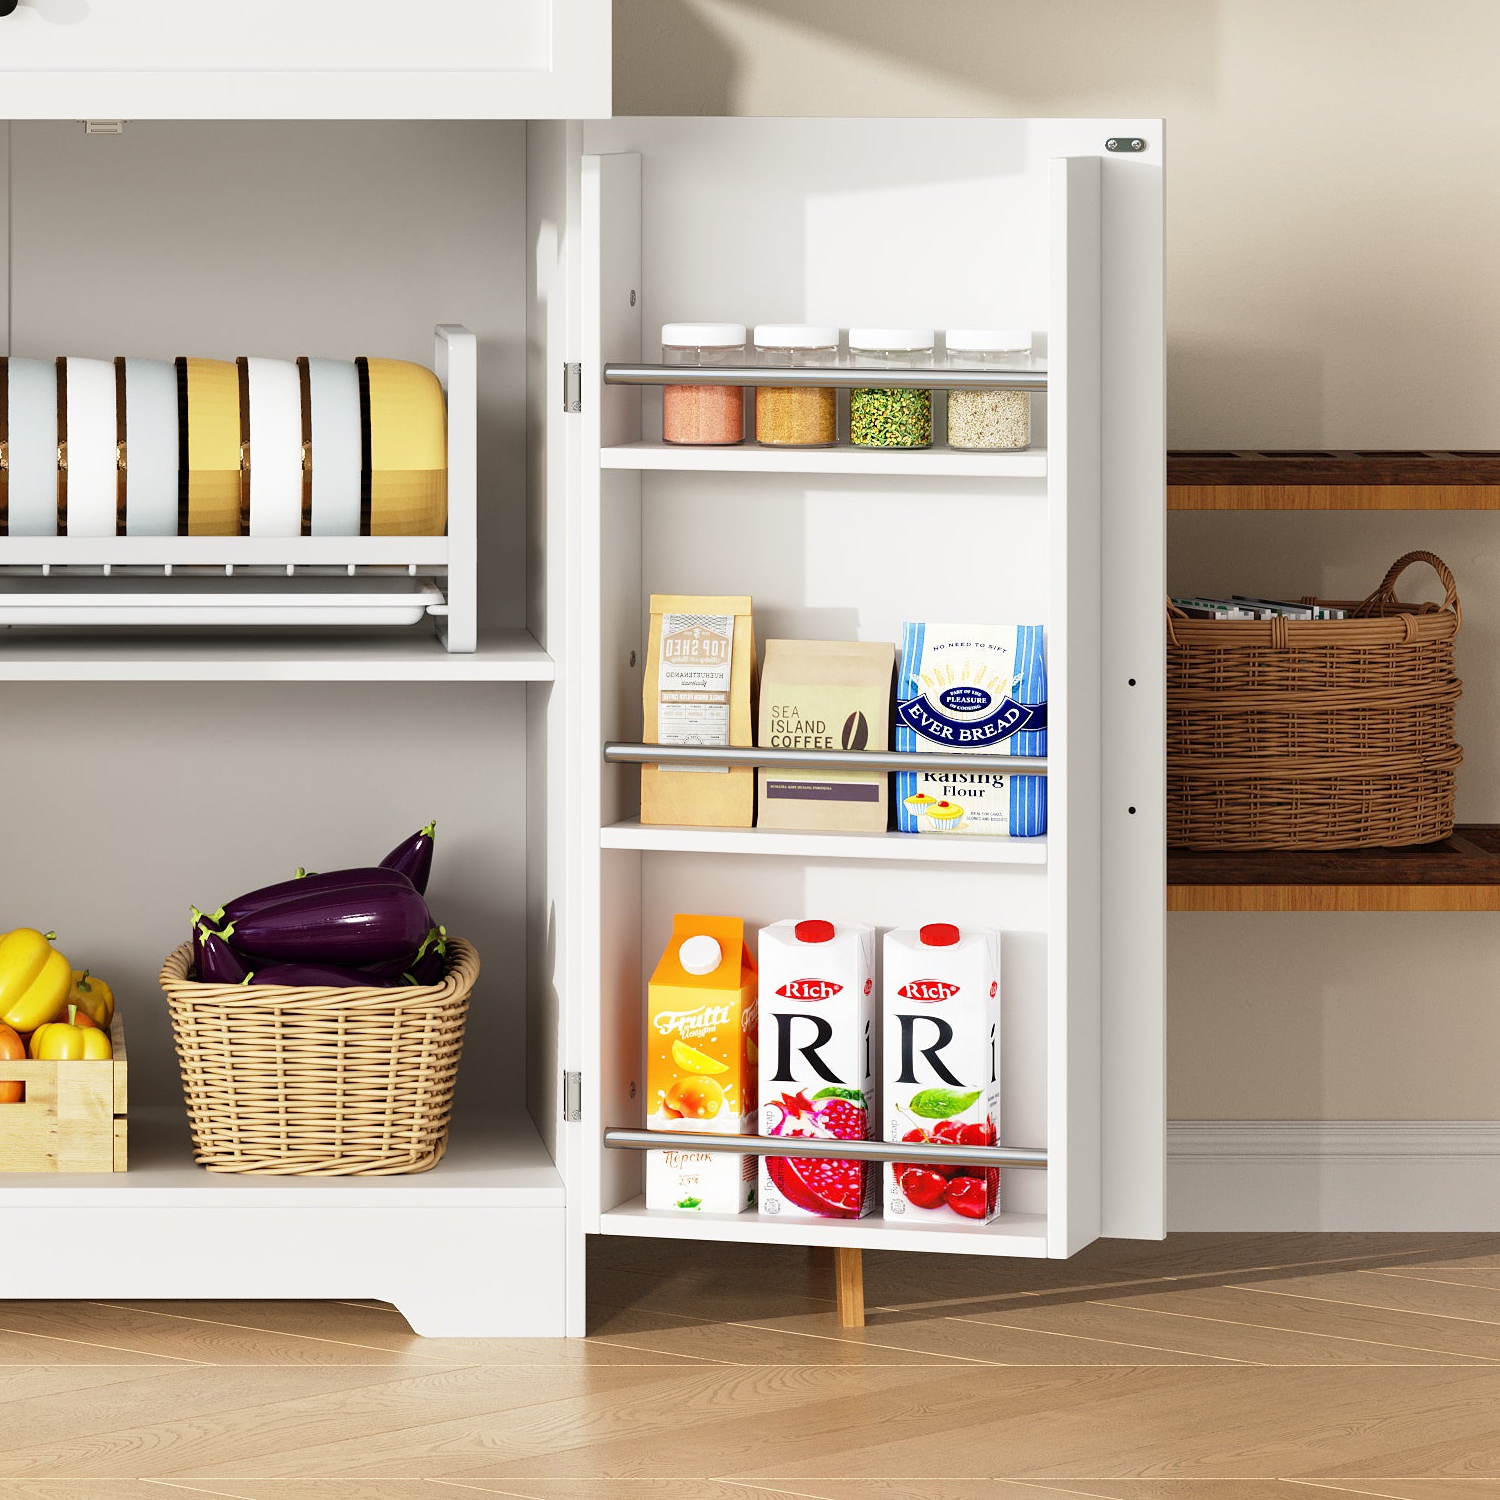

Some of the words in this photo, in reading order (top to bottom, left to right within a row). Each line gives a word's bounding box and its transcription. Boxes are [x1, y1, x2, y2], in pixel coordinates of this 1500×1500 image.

[988, 644, 1007, 654] SIFT
[946, 696, 988, 704] PLEASURE
[772, 706, 800, 719] SEA
[771, 720, 826, 734] ISLAND
[908, 703, 954, 740] EVER
[958, 708, 1021, 742] BREAD
[770, 735, 833, 749] COFFEE
[943, 786, 986, 798] Flour
[785, 982, 834, 998] Rich
[906, 982, 952, 999] Rich
[654, 1004, 731, 1035] Frutti
[768, 1013, 847, 1084] R
[893, 1014, 967, 1088] R
[662, 1150, 713, 1170] Персик
